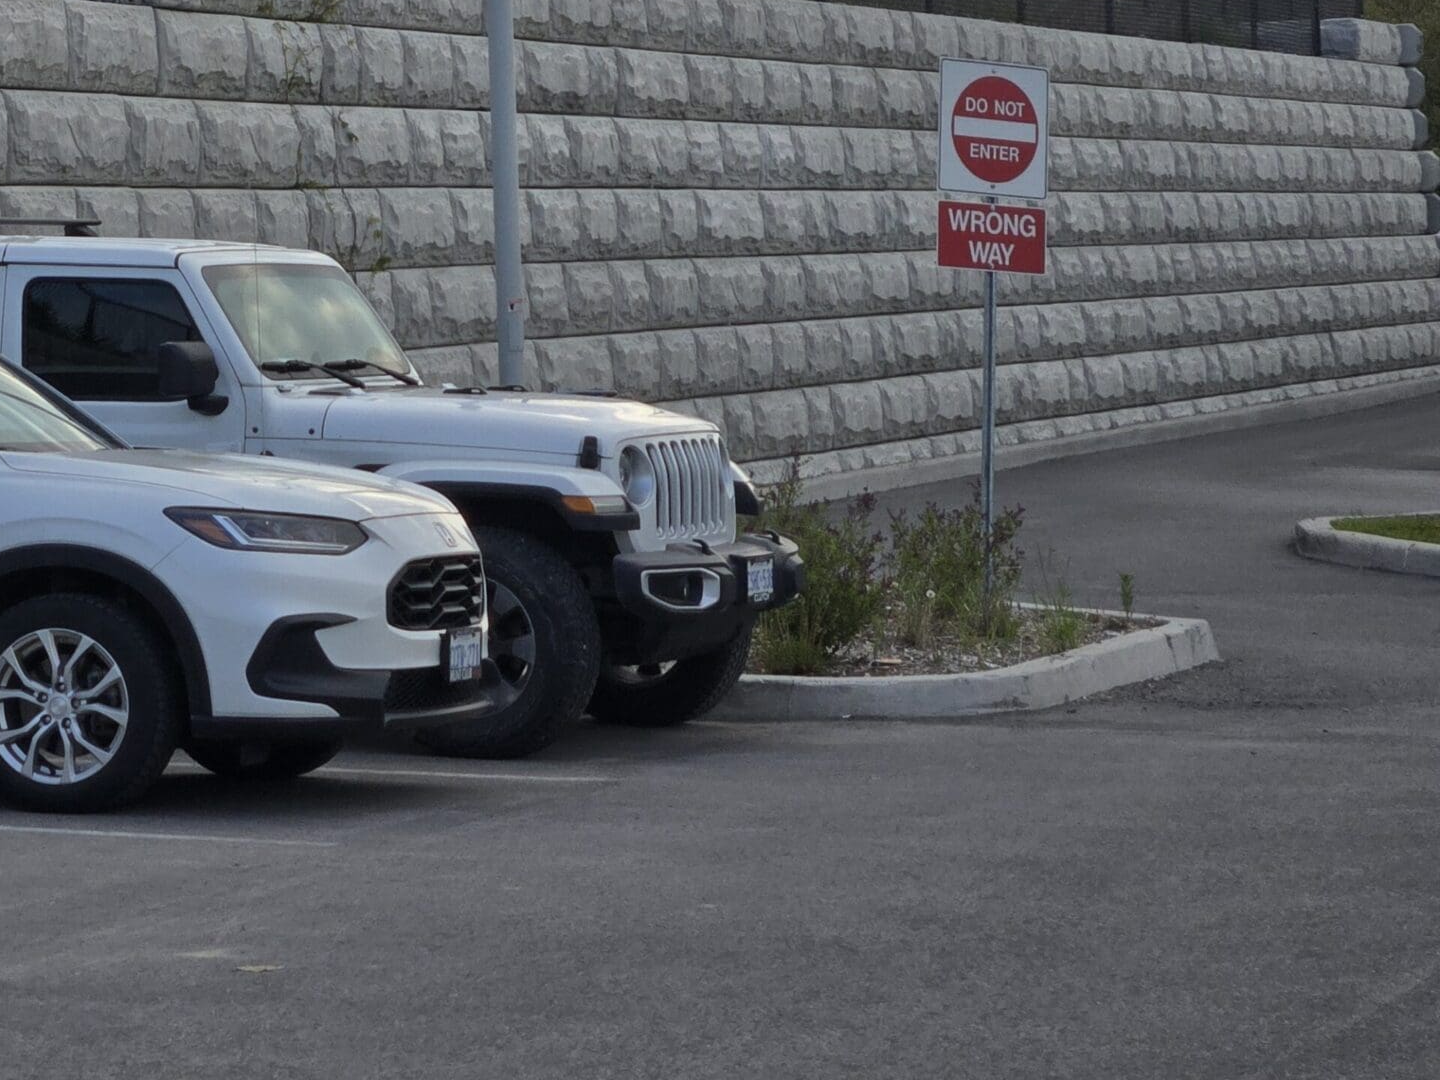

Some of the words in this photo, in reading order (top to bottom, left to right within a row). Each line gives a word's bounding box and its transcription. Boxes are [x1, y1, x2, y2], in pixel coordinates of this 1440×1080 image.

[965, 97, 988, 113] DO
[994, 100, 1026, 117] NOT
[969, 143, 1020, 162] ENTER
[948, 208, 1037, 238] WRONG
[968, 240, 1015, 266] WAY
